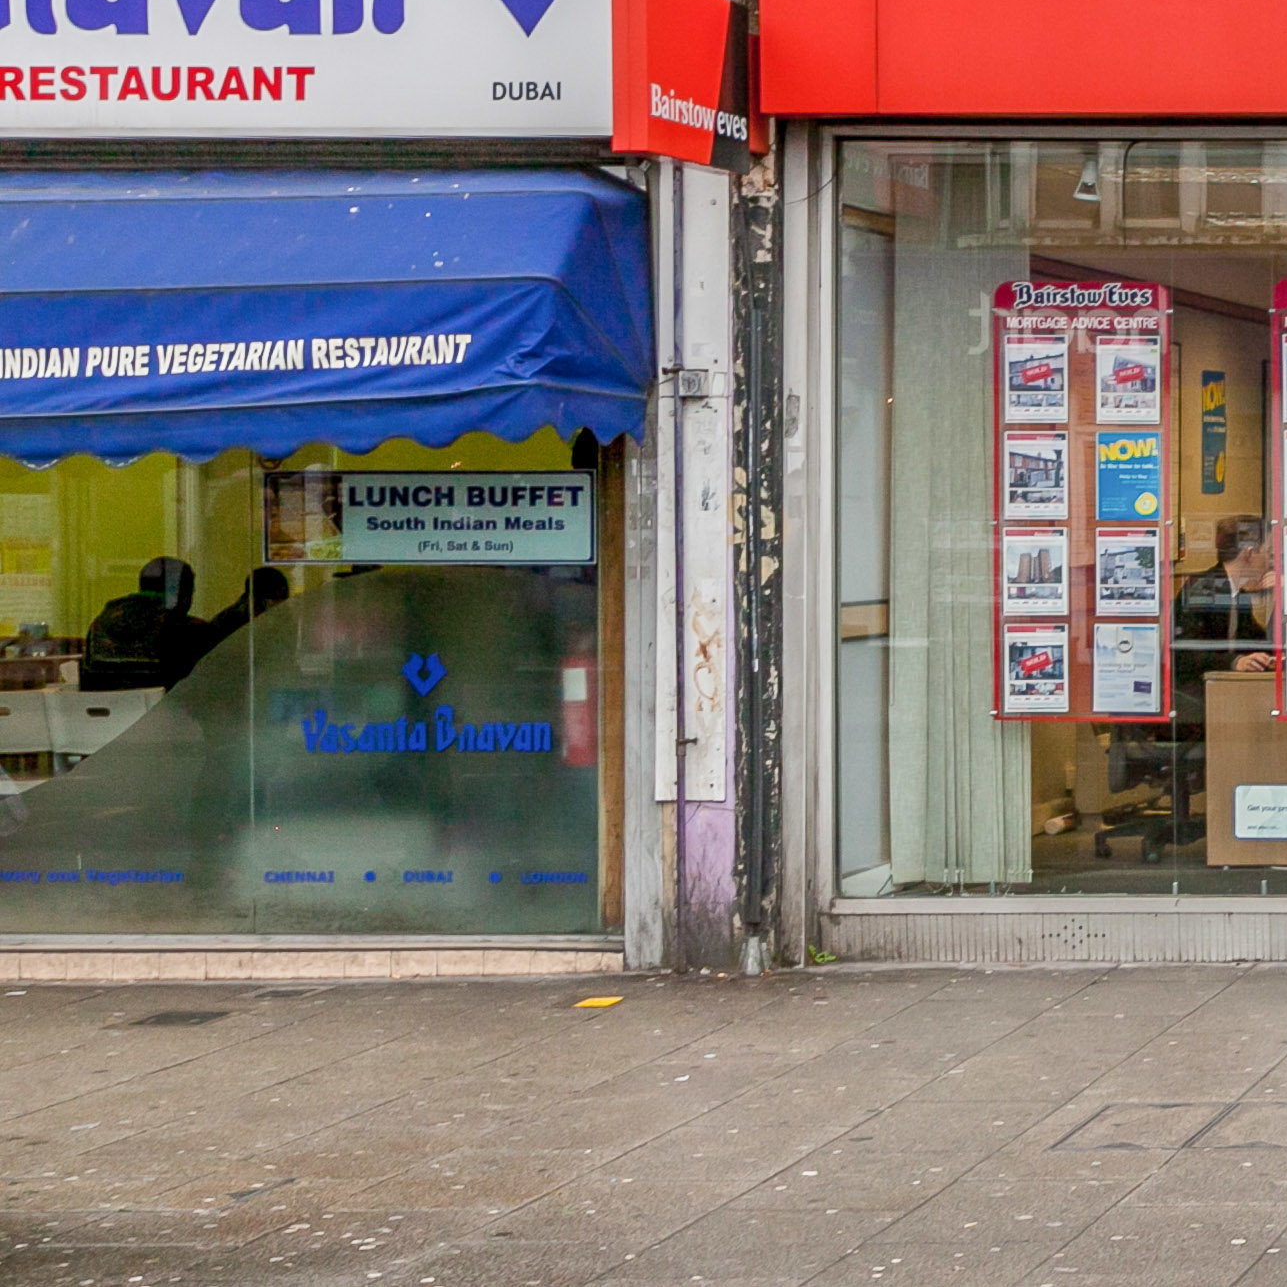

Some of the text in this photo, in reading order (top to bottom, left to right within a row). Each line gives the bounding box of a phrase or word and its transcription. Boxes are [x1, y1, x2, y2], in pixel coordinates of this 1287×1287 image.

[0, 65, 316, 102] RESTAURANT
[492, 81, 562, 101] DUBAI
[650, 83, 748, 141] Bairstow eves
[1012, 282, 1153, 309] Bairstow Eves
[1006, 316, 1158, 330] MORTGAGE ADVICE CENTRE
[0, 334, 472, 379] INDIAN PURE VEGETARIAN RESTAURANT
[1099, 438, 1158, 462] NOW!
[348, 485, 584, 507] LUNCH BUFFET
[366, 516, 565, 531] South Indian Meals
[418, 540, 514, 553] (Fri, Sat & Sun)
[302, 704, 551, 753] Vasanta Bhavan
[0, 870, 40, 884] very
[85, 869, 184, 886] Vegetarian
[264, 870, 335, 883] CHENNAI
[403, 870, 453, 883] DUBAI
[521, 871, 587, 884] LONDON
